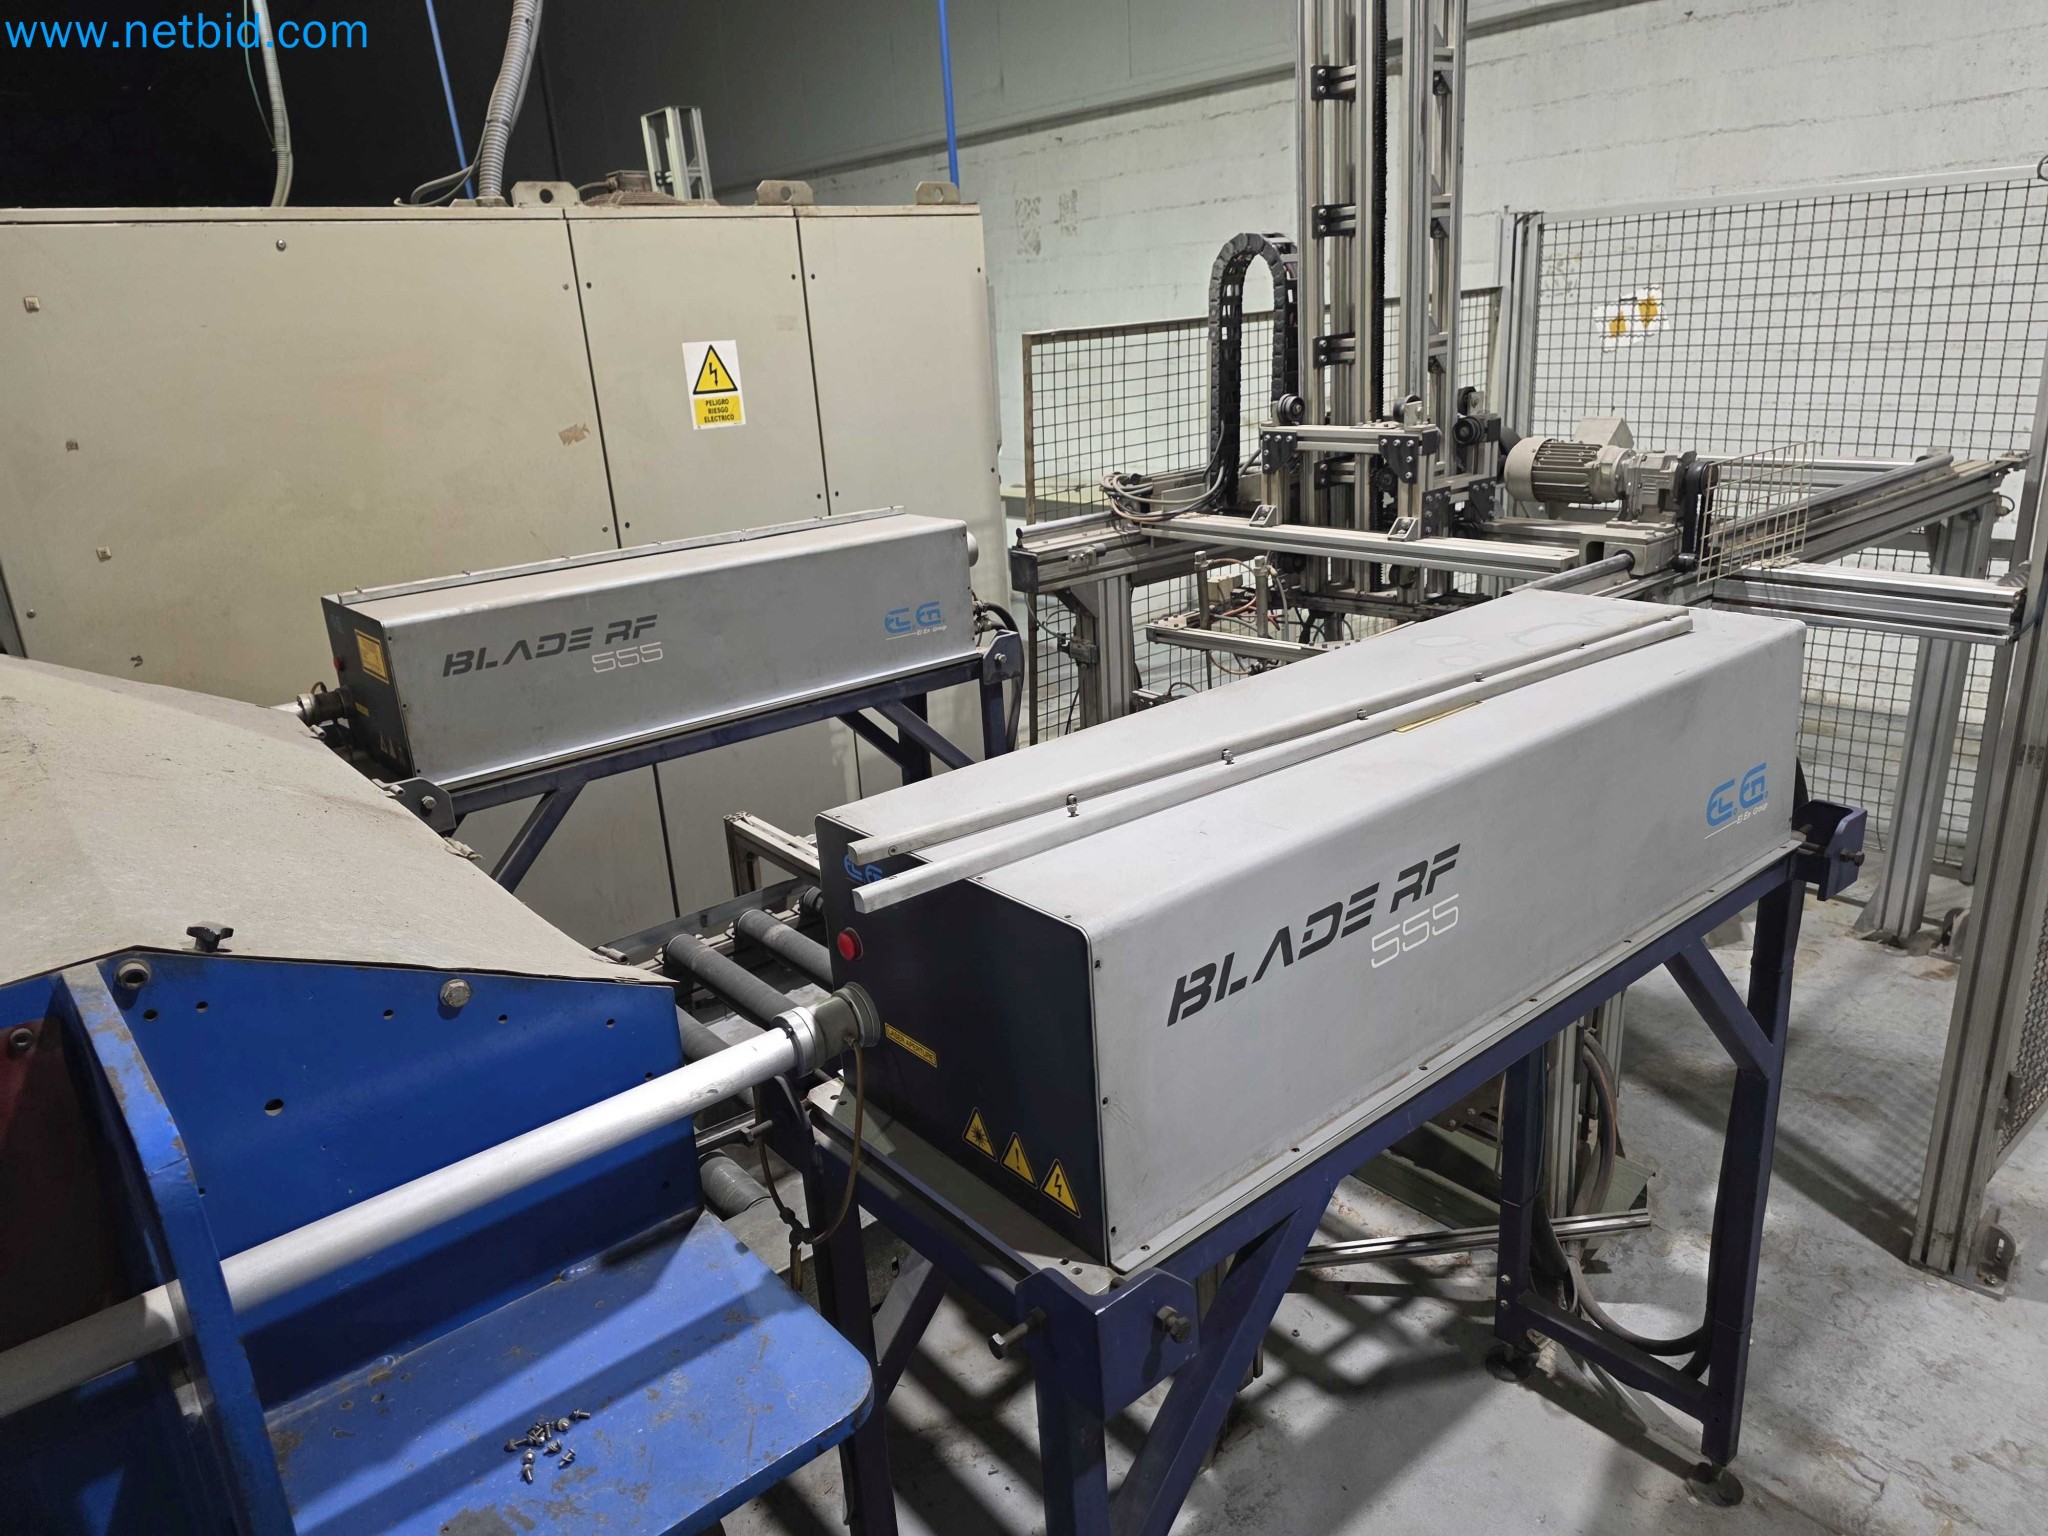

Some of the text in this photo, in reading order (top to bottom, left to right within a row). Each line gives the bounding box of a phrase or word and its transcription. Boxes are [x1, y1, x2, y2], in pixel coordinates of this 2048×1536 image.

[703, 413, 735, 423] ELECTRICO
[705, 398, 729, 407] PELIGRO
[707, 406, 729, 415] RIESGO
[442, 614, 658, 678] BLADE RF
[591, 641, 664, 673] 555
[1166, 842, 1461, 1028] BLADE RF
[1370, 893, 1460, 969] 555
